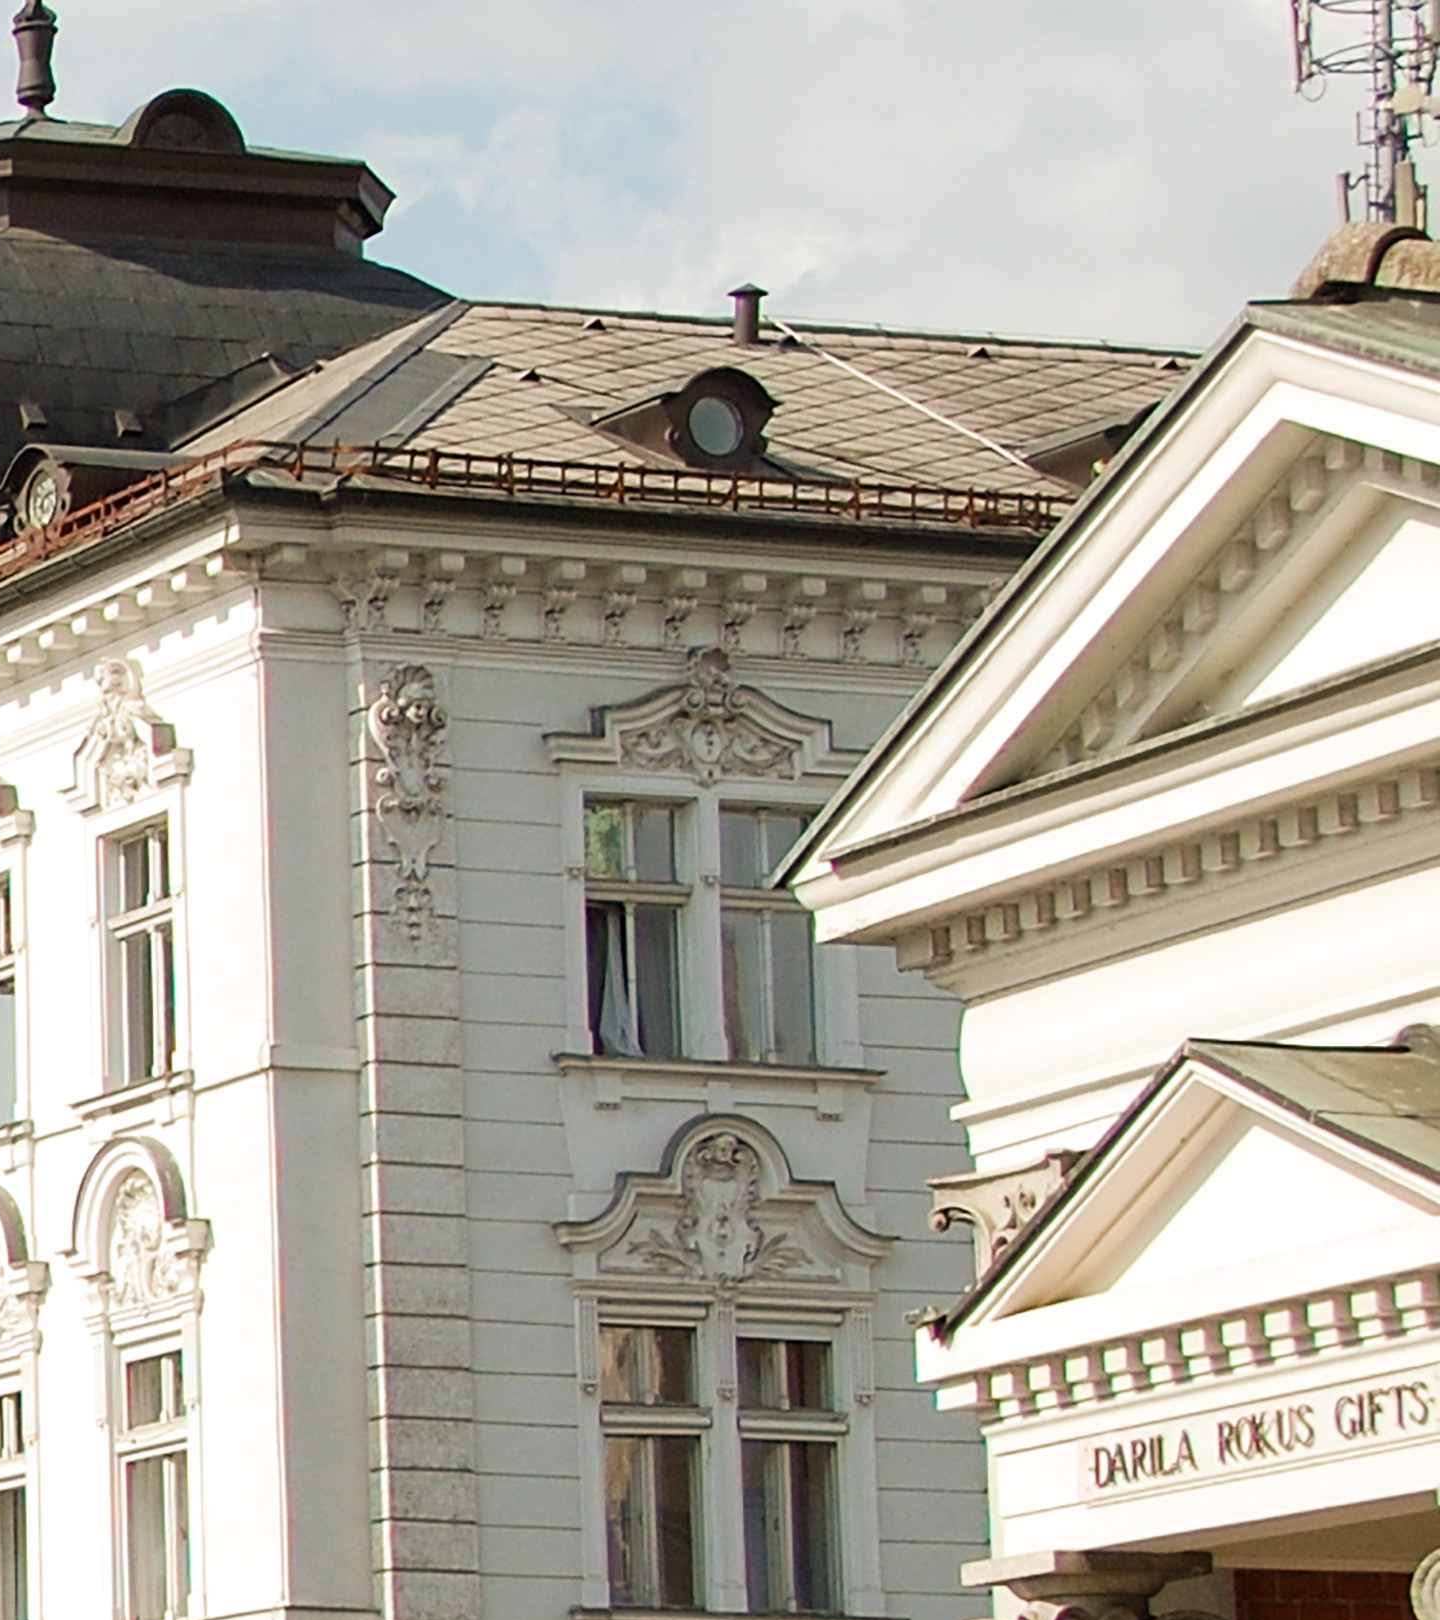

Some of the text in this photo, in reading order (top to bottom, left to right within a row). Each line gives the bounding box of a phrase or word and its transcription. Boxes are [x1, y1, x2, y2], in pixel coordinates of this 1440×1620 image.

[1092, 1380, 1431, 1488] DARILA ROKUS GIFTS
